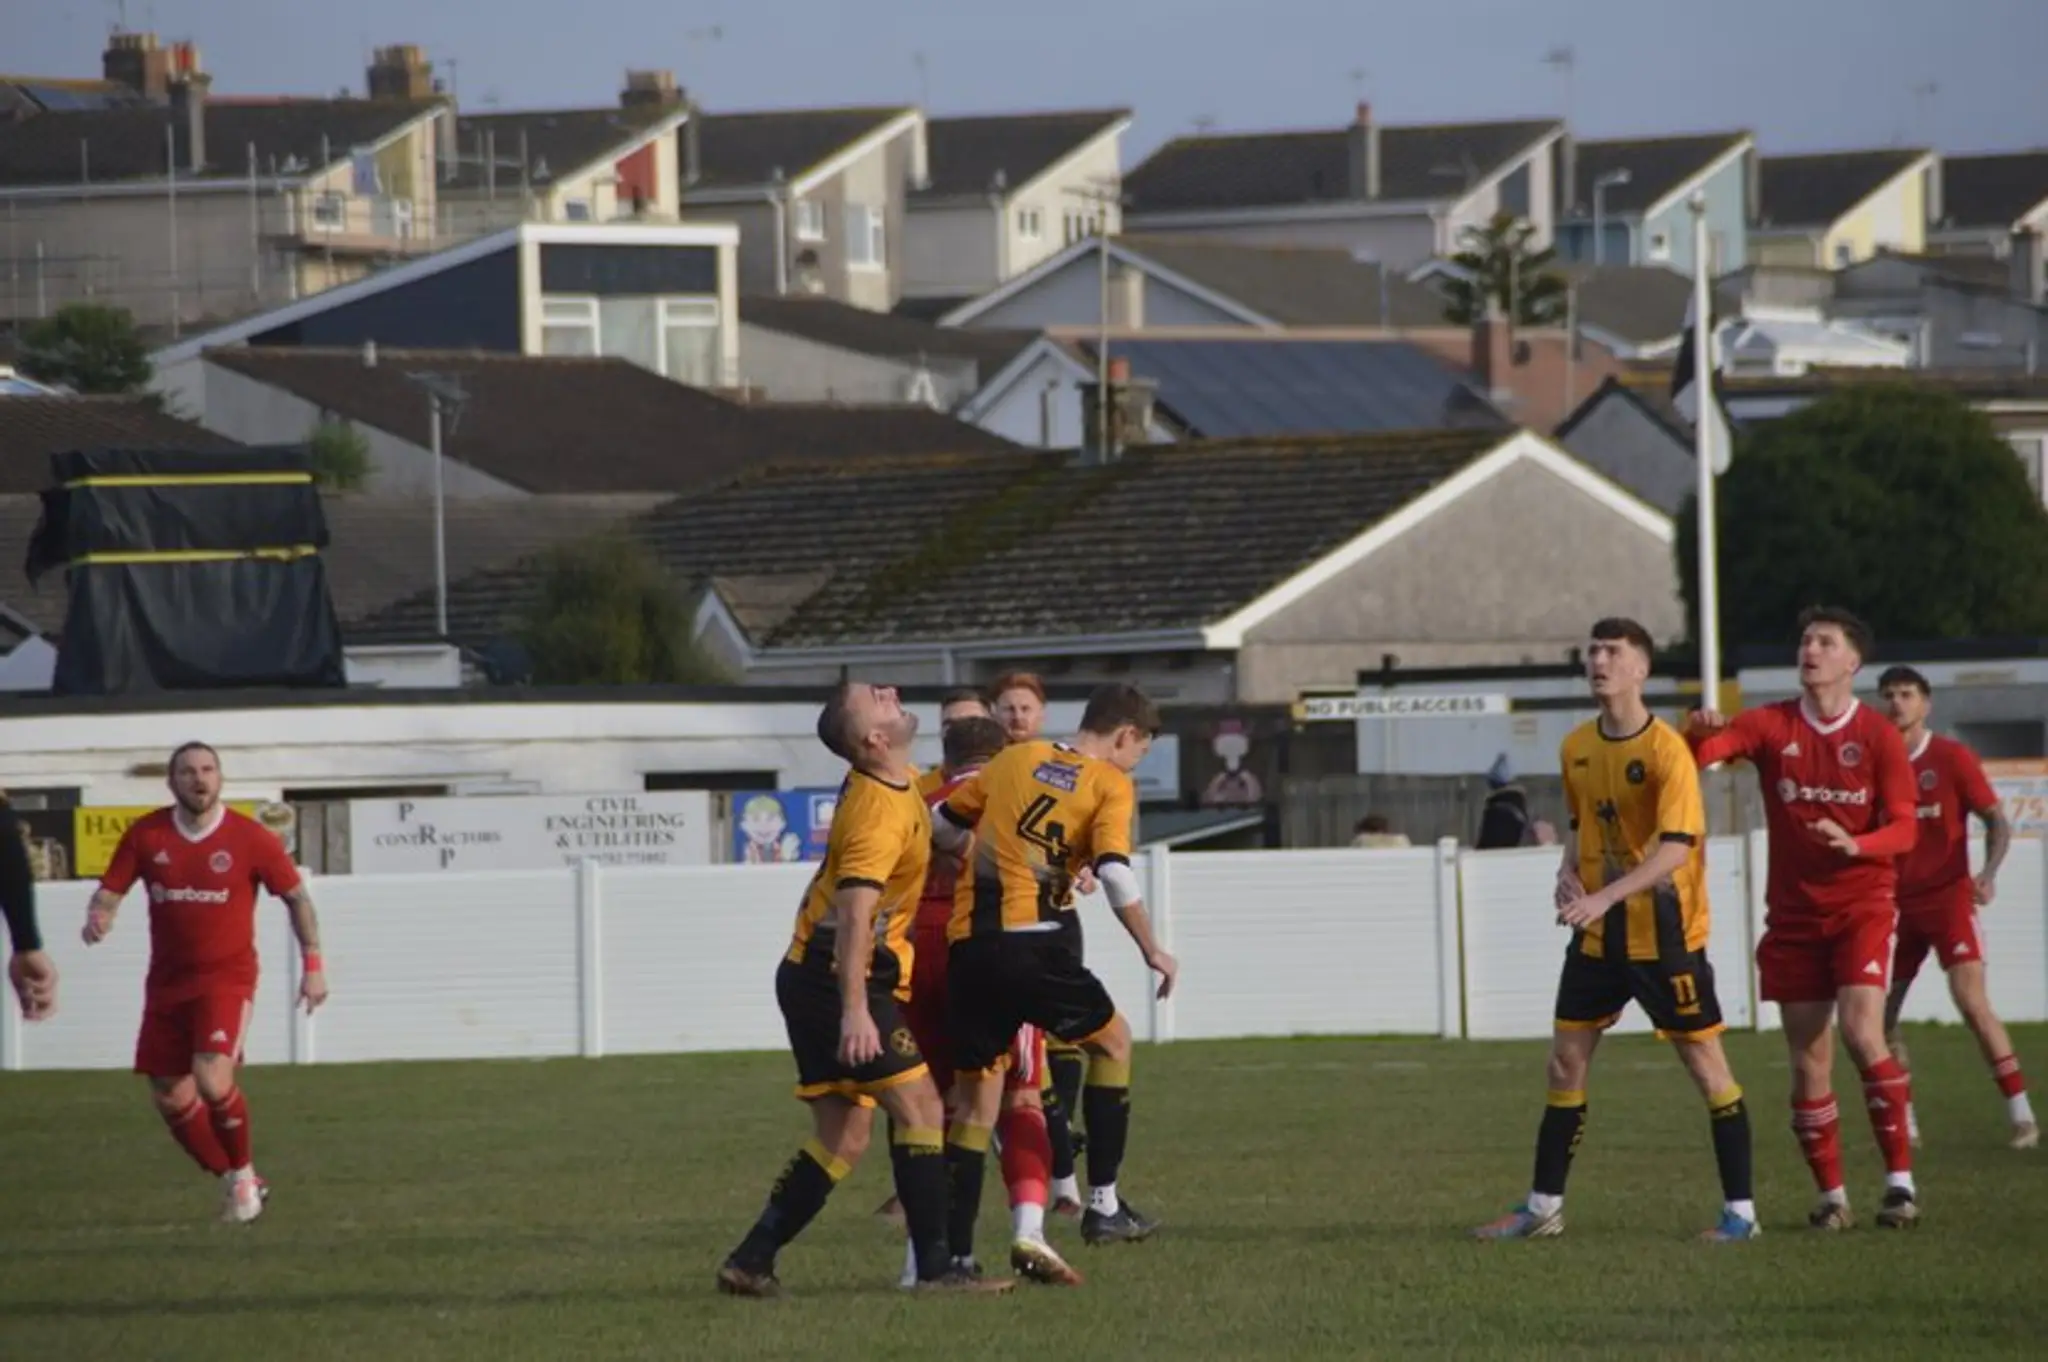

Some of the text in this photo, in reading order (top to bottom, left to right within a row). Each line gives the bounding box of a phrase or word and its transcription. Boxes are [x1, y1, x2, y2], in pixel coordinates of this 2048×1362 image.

[1304, 697, 1487, 714] NO PUBLIC ACCESS
[399, 802, 415, 822] P
[586, 797, 643, 812] CIVIL
[545, 813, 686, 831] ENGINEERING
[1016, 793, 1070, 866] 4
[555, 830, 676, 848] & UTILITIES
[1670, 974, 1697, 1004] 11
